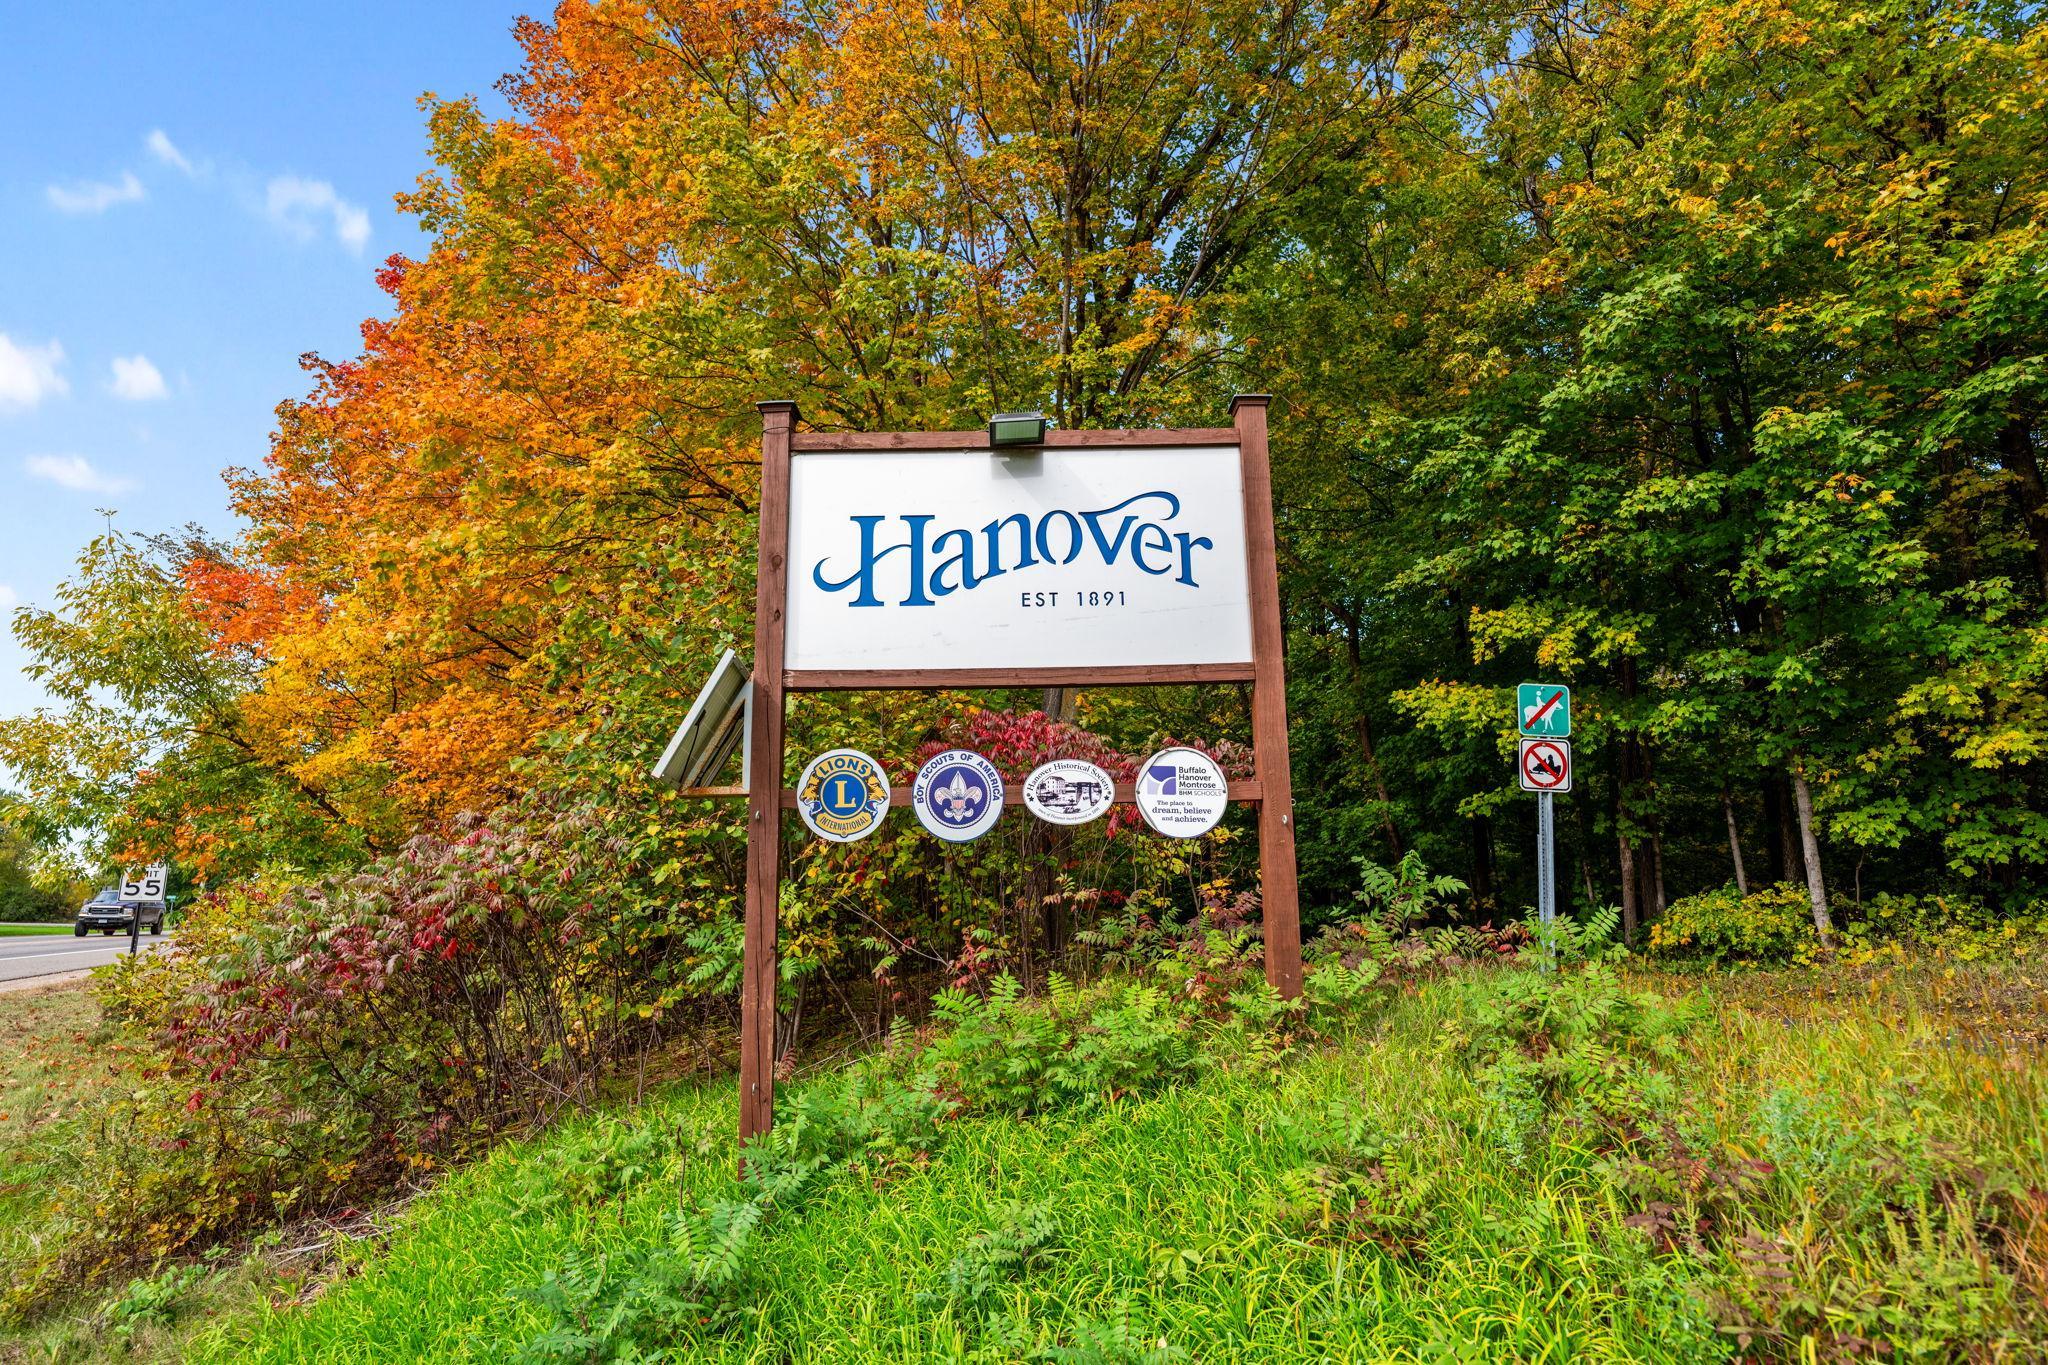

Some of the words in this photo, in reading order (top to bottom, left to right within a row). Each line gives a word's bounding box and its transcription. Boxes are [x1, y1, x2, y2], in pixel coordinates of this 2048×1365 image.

[812, 490, 1214, 608] Hanover
[1021, 592, 1059, 607] EST
[1077, 591, 1125, 607] 1891
[818, 757, 869, 776] LIONS
[1178, 766, 1207, 774] Buffalo
[916, 784, 925, 804] BOY
[921, 753, 955, 780] SCOUTS
[959, 753, 974, 762] OF
[976, 760, 1001, 801] AMERICA
[1026, 766, 1053, 792] Hanover
[1053, 762, 1091, 772] Historical
[1090, 768, 1110, 791] Society
[1178, 781, 1217, 789] Montrose
[834, 780, 857, 809] L
[1151, 807, 1182, 815] dream,
[1183, 807, 1212, 815] believe
[1169, 800, 1186, 808] place
[819, 816, 869, 832] INTERNATIONAL
[123, 880, 161, 896] 55
